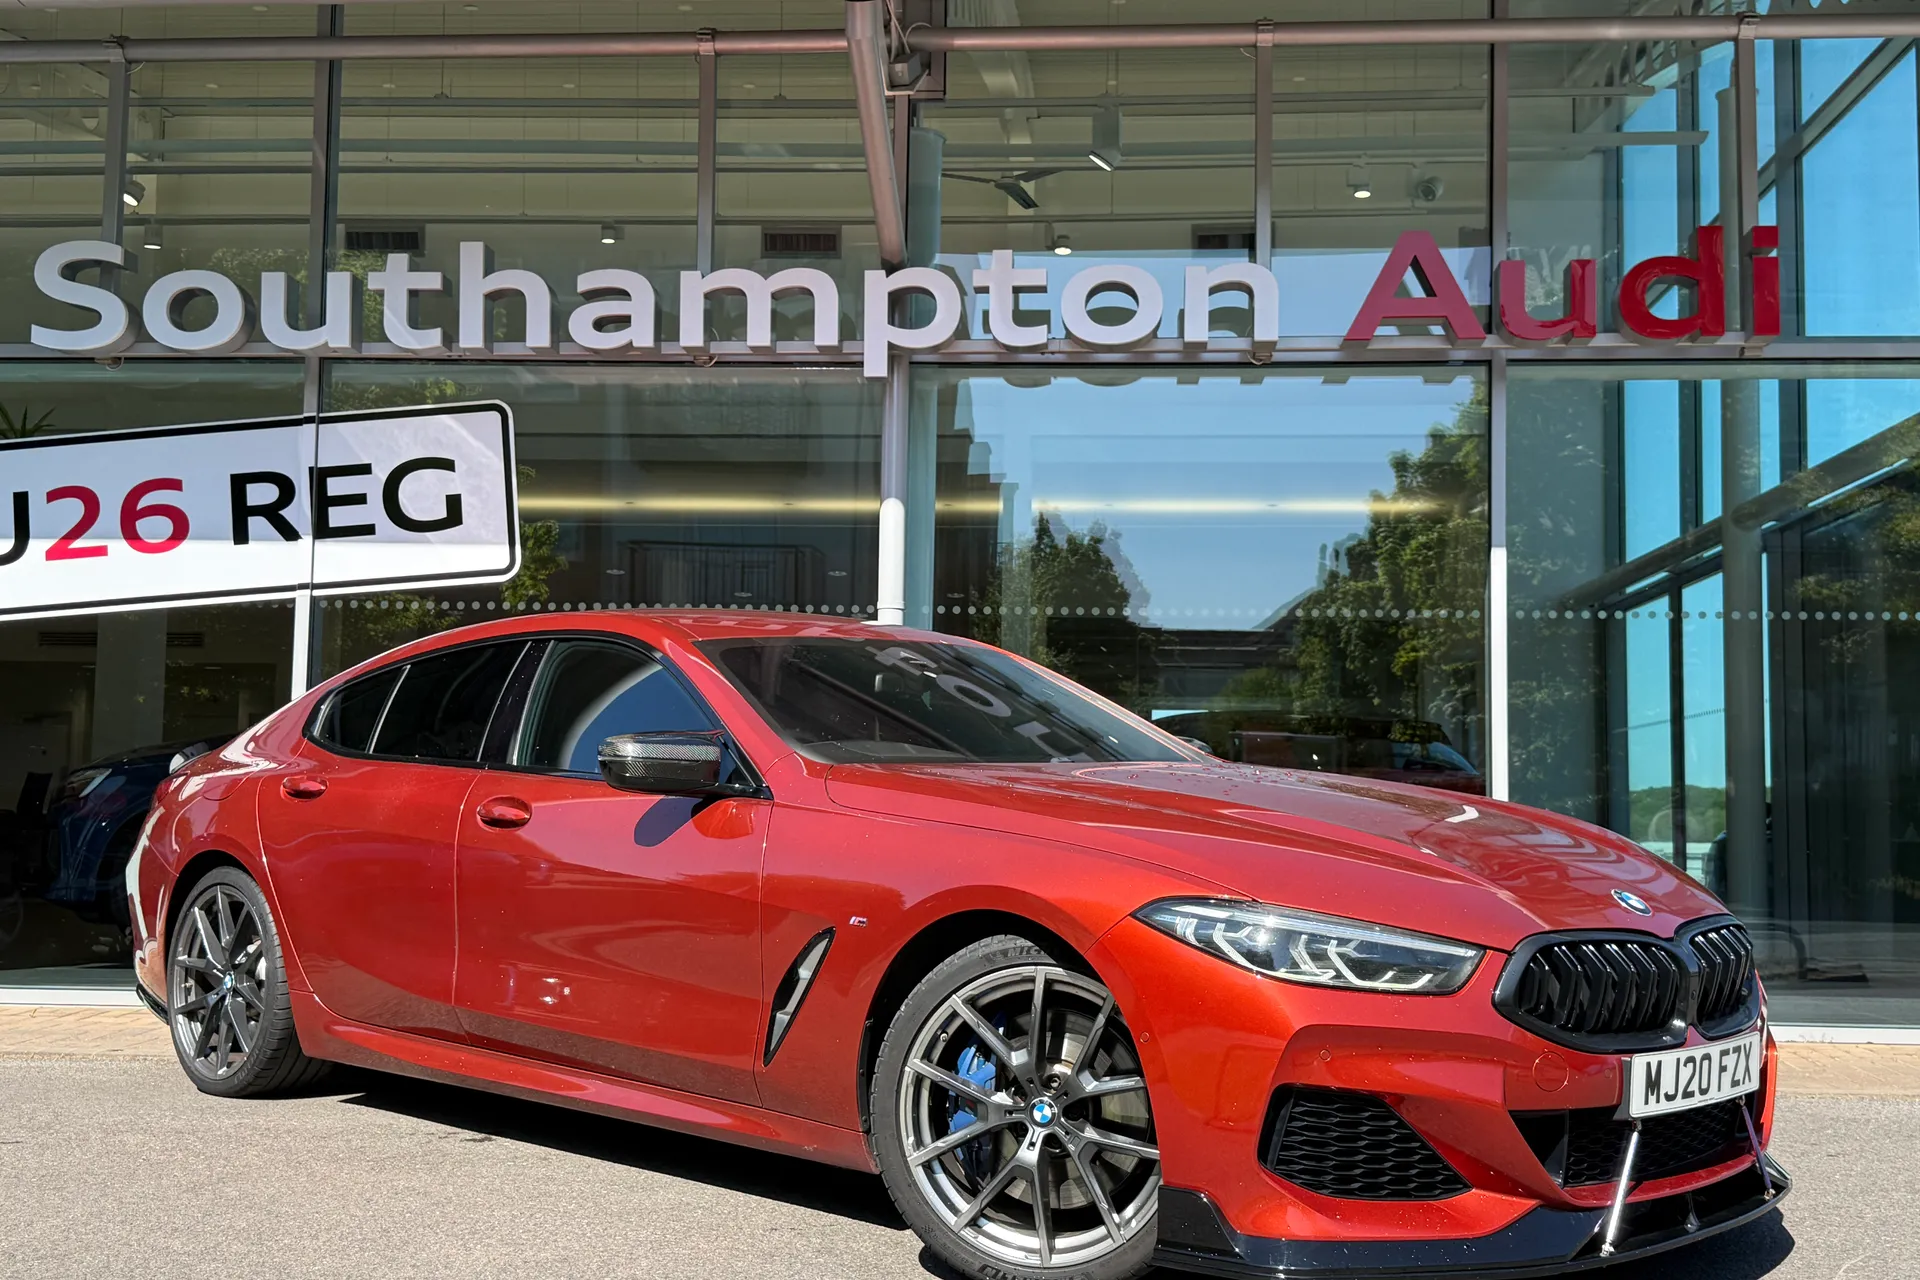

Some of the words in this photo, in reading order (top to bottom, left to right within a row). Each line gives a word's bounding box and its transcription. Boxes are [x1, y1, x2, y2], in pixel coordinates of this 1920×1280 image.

[30, 240, 1280, 378] Southampton
[1342, 226, 1780, 344] Audi
[230, 457, 463, 546] REG
[1643, 1052, 1712, 1106] MJ20
[1717, 1041, 1753, 1093] FZX
